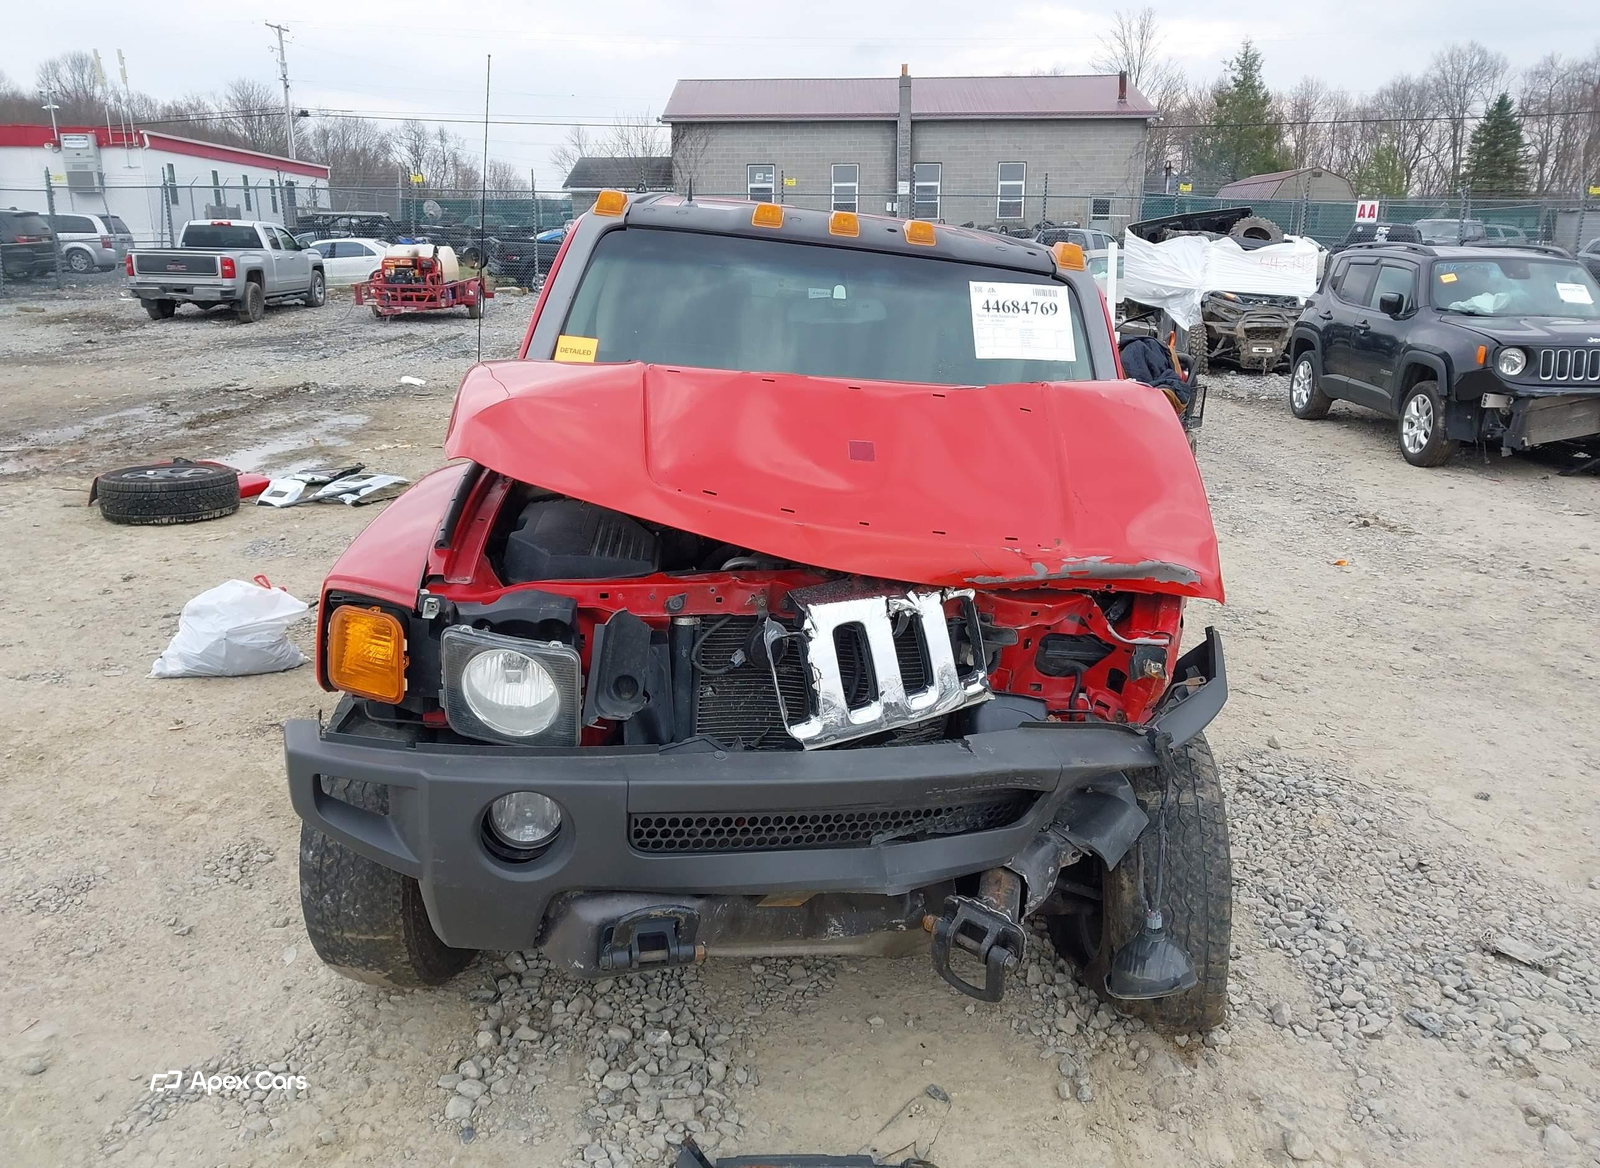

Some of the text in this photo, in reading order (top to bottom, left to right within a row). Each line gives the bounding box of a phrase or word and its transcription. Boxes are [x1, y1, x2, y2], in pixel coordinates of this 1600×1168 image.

[1357, 204, 1376, 218] AA
[981, 299, 1058, 316] 44684769
[560, 347, 592, 356] DETAILED
